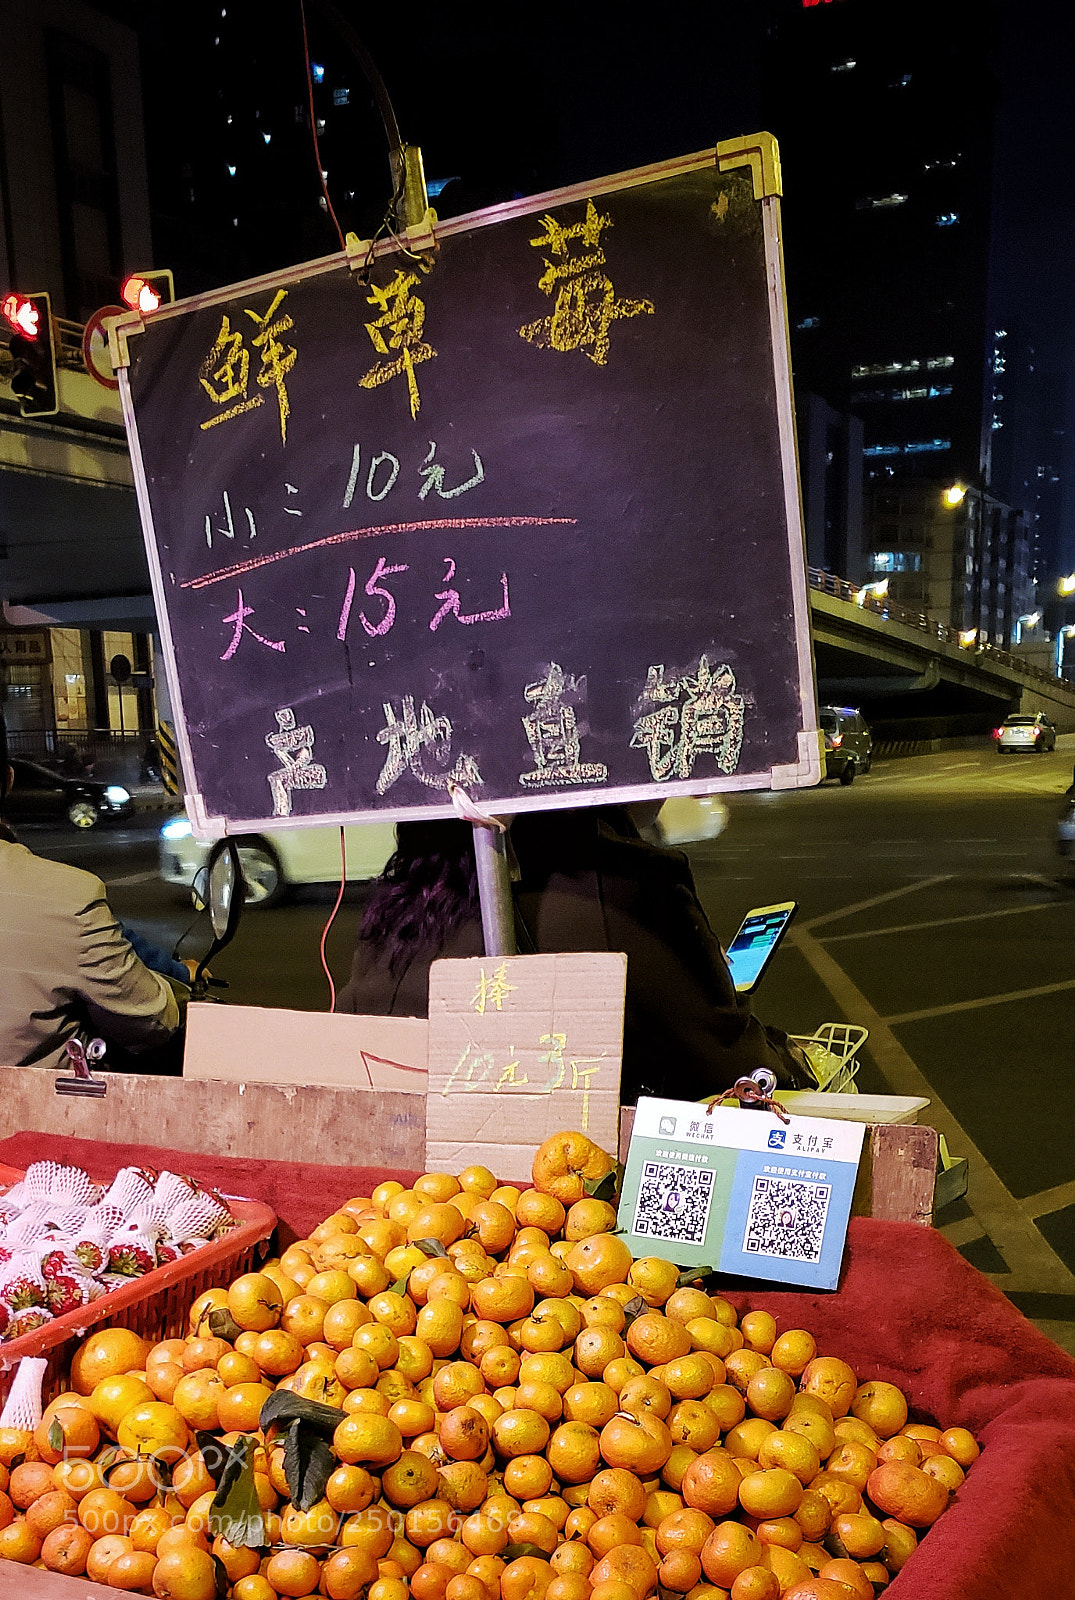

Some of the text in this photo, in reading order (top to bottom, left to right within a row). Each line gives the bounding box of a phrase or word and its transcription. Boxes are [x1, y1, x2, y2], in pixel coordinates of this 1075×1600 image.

[689, 1120, 714, 1134] 微信
[685, 1131, 714, 1140] WECHAT
[792, 1133, 834, 1149] 支付宝
[796, 1145, 826, 1154] ALIPAY
